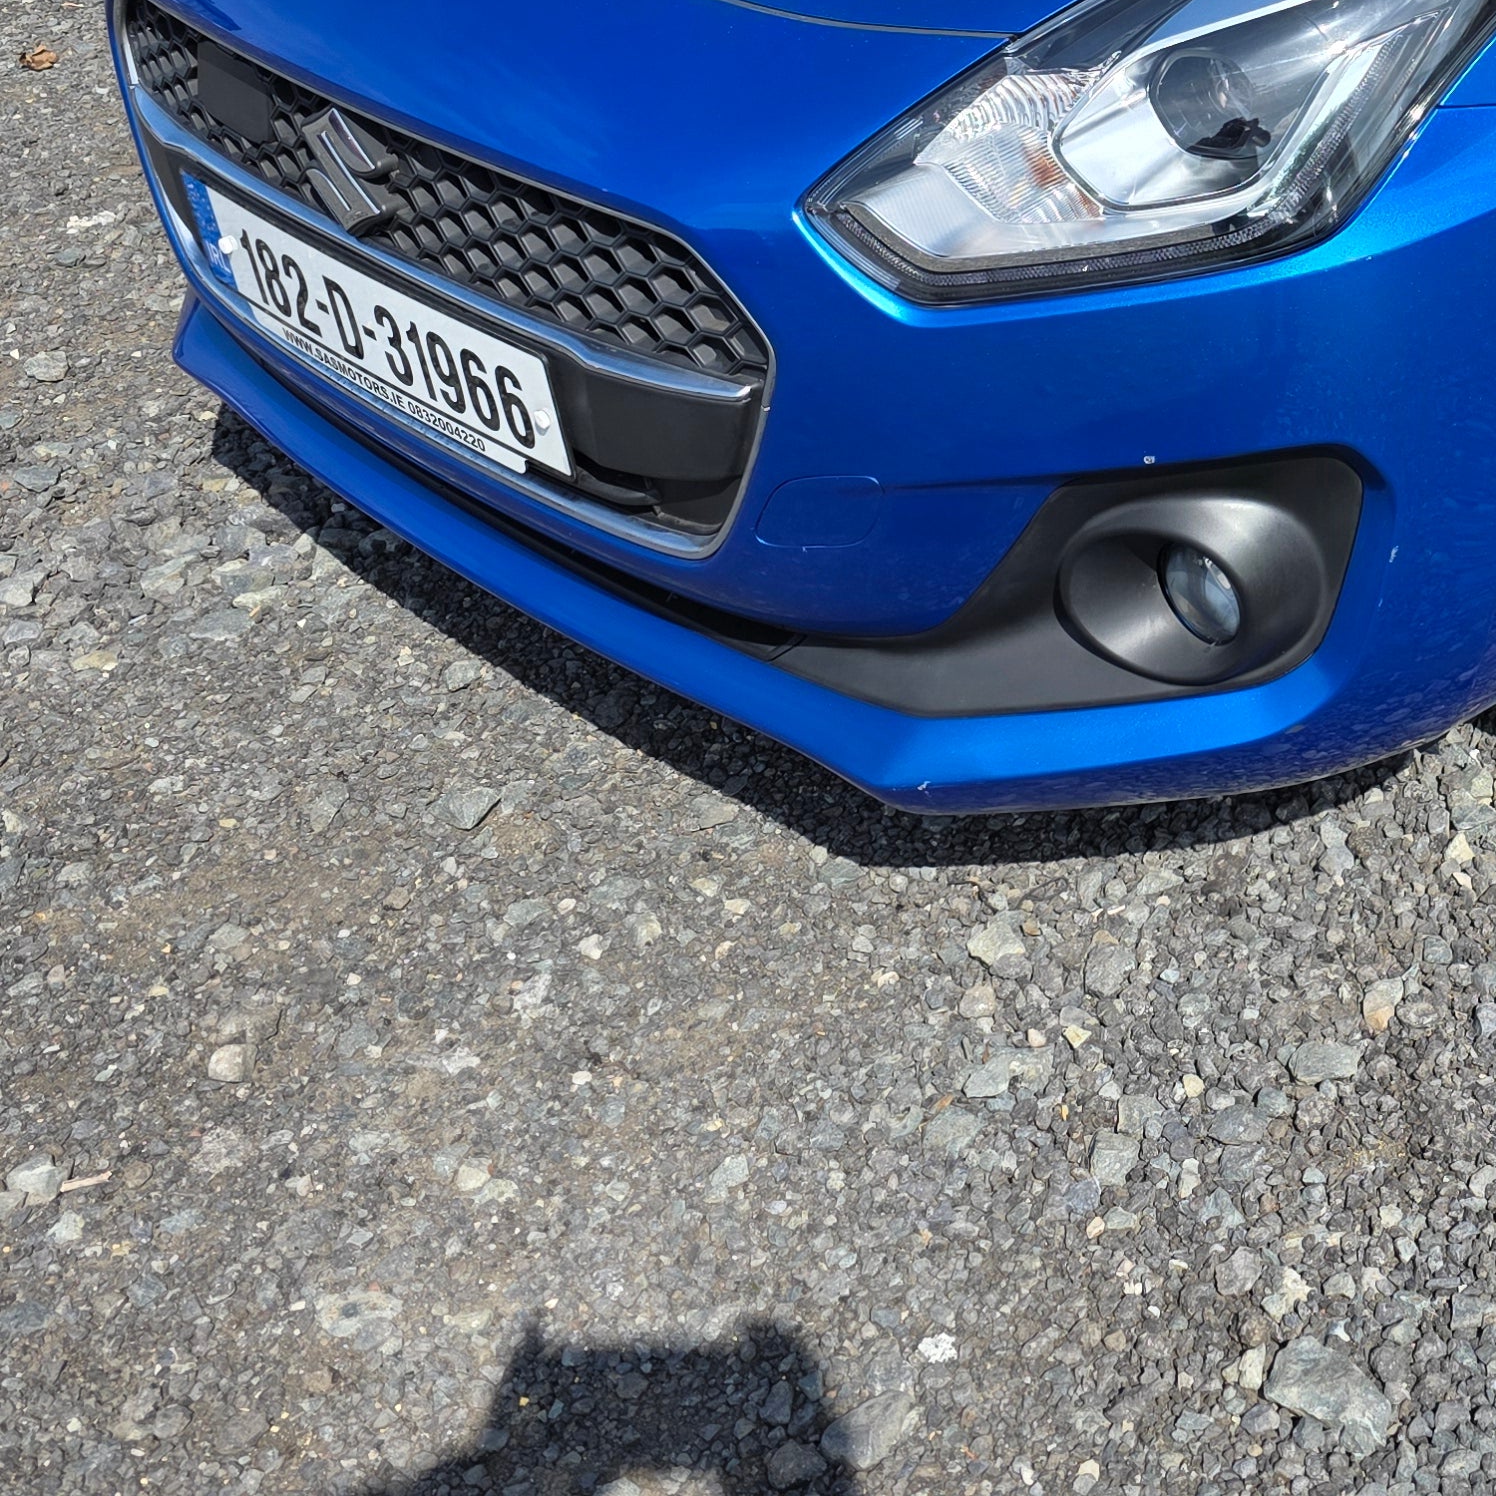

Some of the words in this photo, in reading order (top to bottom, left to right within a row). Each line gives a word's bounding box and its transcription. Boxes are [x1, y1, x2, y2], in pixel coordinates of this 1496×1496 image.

[240, 228, 536, 450] 182-D-31966
[282, 327, 406, 409] WWW.SASMOTORS.IE
[408, 401, 486, 452] 0832004220
